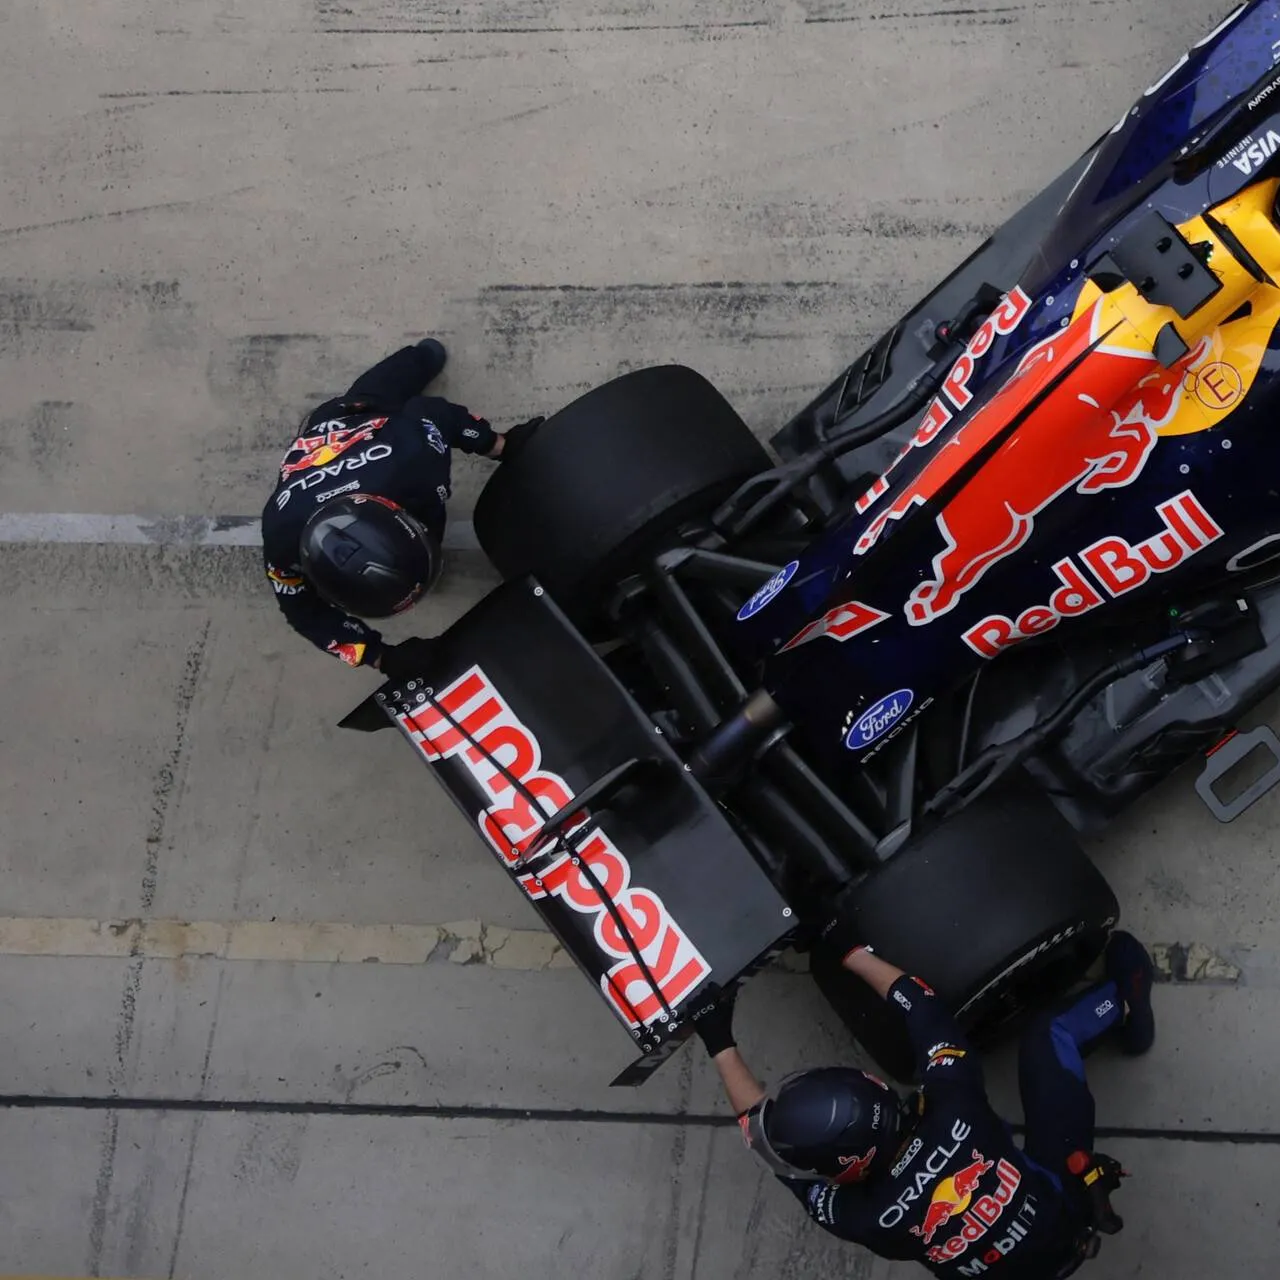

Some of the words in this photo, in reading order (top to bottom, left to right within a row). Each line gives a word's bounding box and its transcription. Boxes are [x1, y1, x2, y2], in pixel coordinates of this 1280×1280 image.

[1217, 136, 1252, 168] INFINITE
[942, 285, 1032, 411] Red
[277, 444, 392, 511] ORACLE
[315, 480, 360, 503] sparco
[749, 570, 787, 609] Ford
[961, 556, 1106, 660] Red
[1077, 489, 1225, 598] Bull
[859, 699, 903, 741] Ford
[861, 696, 934, 764] RACING
[397, 664, 592, 869] Bull
[516, 827, 711, 1027] Red
[878, 1119, 971, 1228] ORACLE
[891, 1138, 924, 1179] sparco
[971, 1157, 1021, 1227] Bull
[957, 1220, 1028, 1277] Mobil
